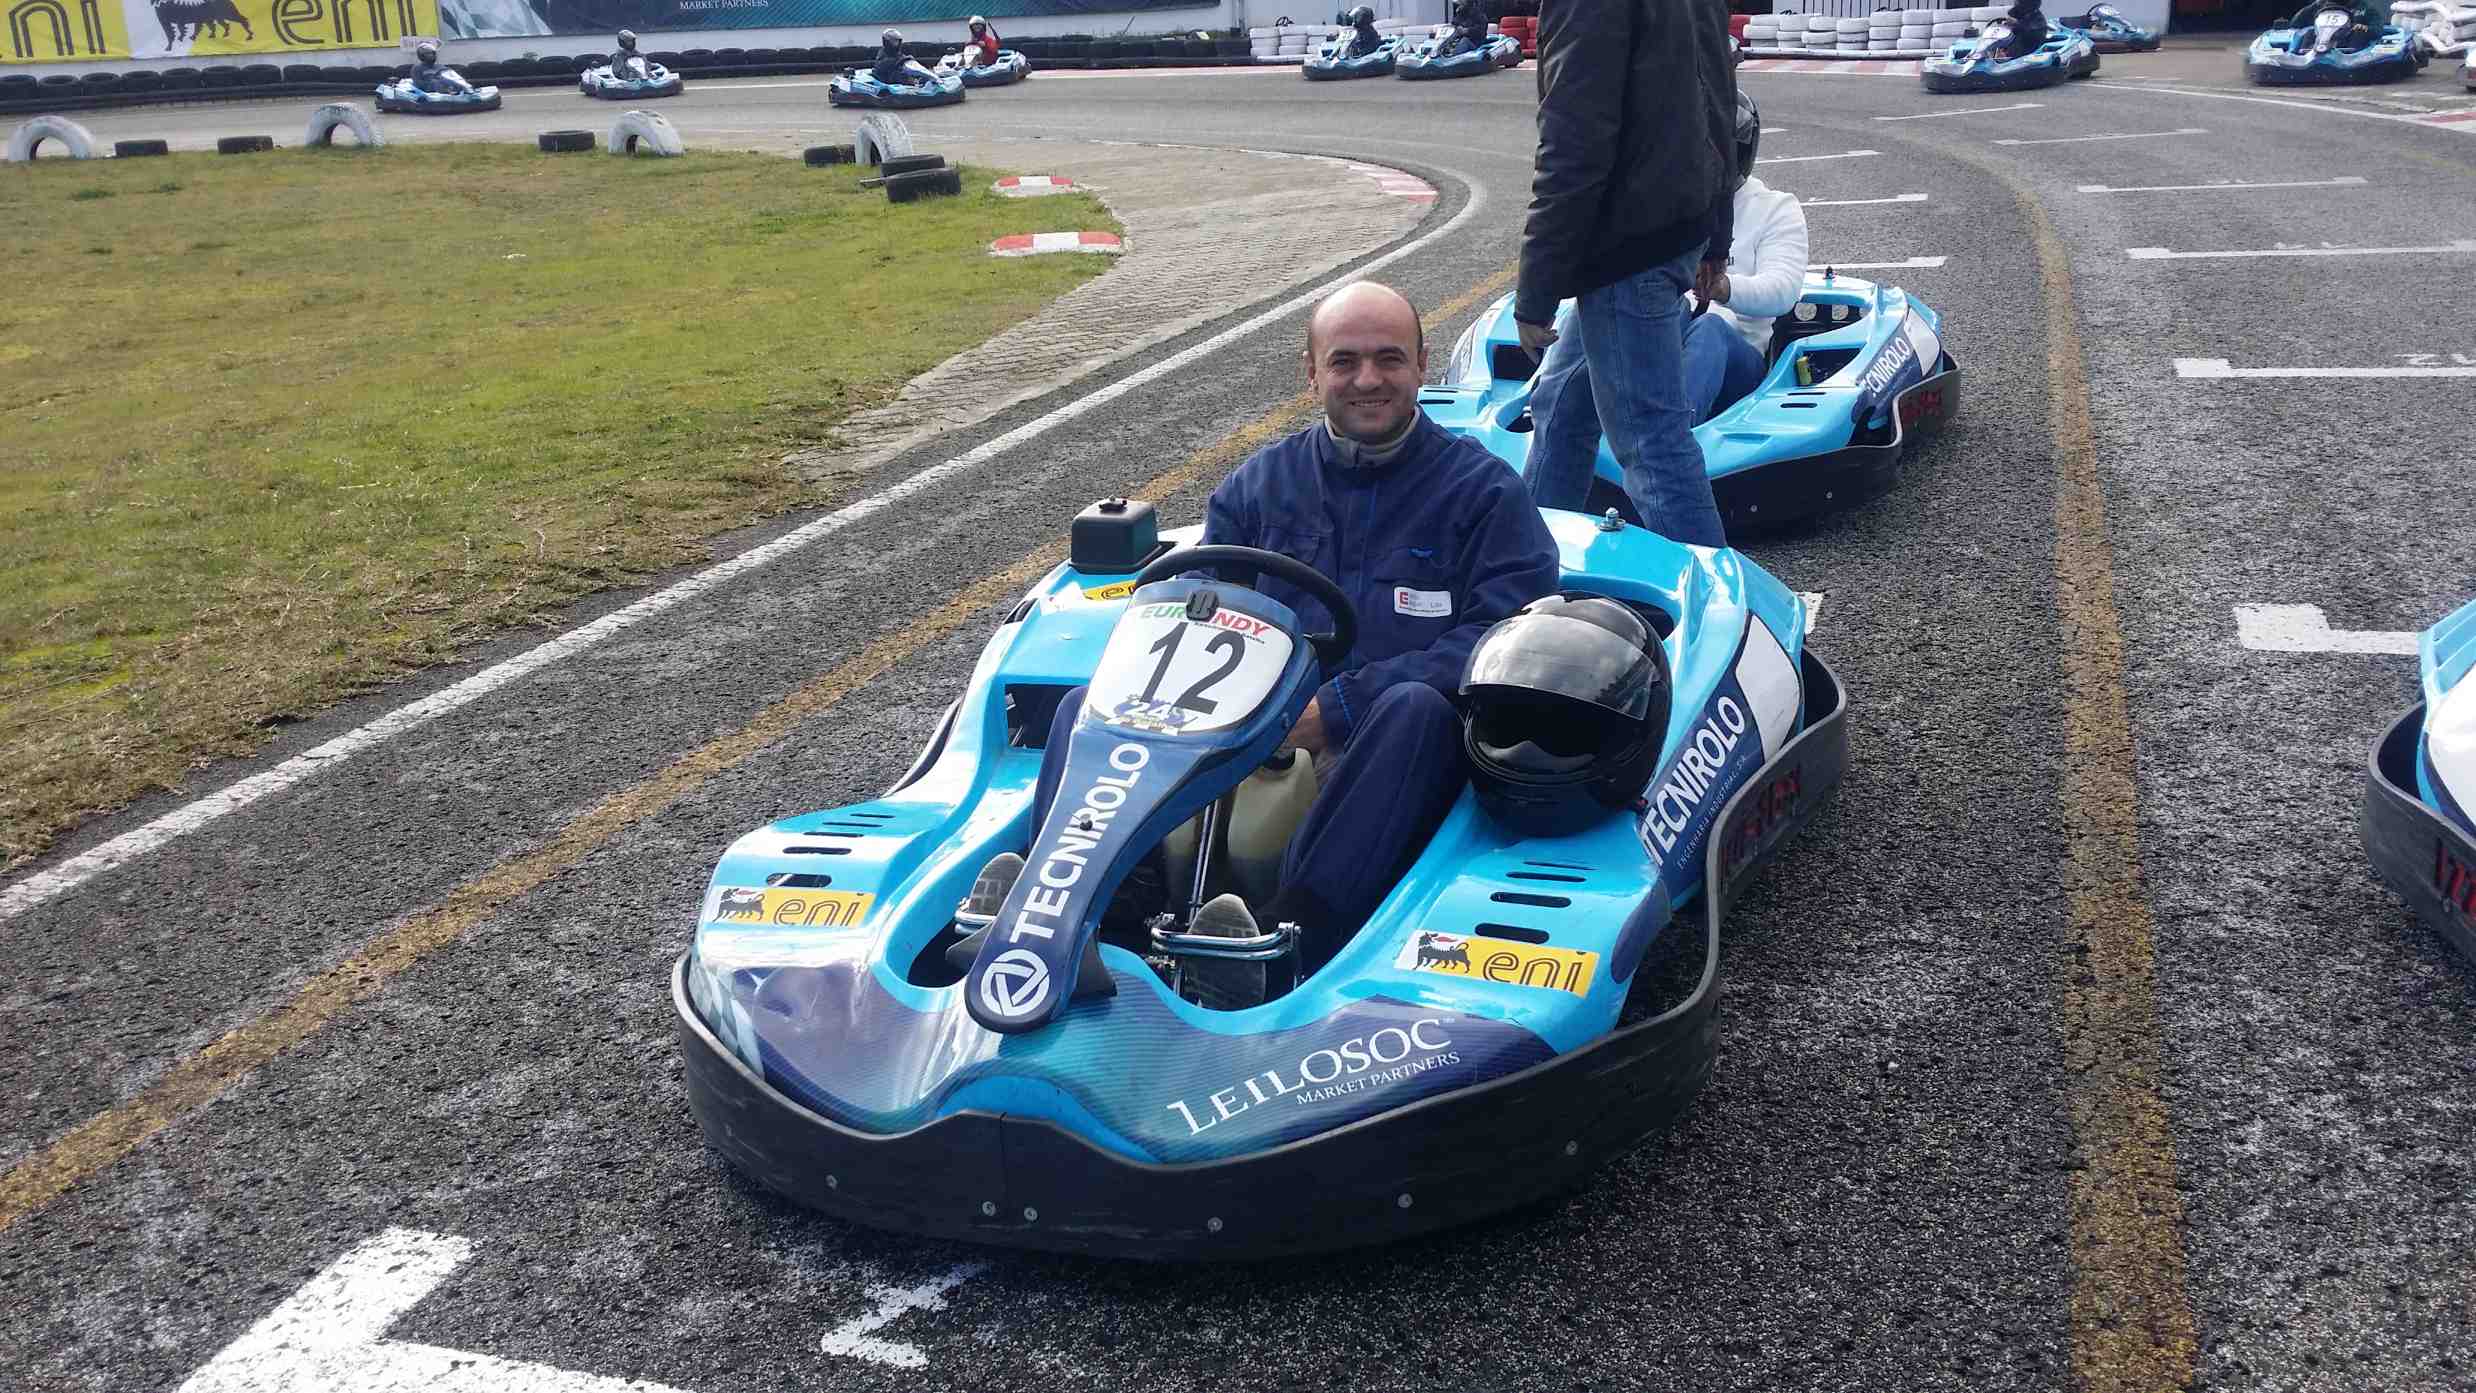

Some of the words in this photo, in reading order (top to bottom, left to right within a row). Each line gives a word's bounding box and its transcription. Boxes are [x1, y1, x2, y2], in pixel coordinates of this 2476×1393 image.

[1140, 622, 1245, 715] 12
[1639, 696, 1745, 867] TECNIROLO
[1009, 743, 1150, 943] TECNIROLO
[773, 892, 864, 926] eni
[1482, 950, 1587, 993] eni
[1167, 1018, 1452, 1136] LEILOSOC
[1296, 1077, 1366, 1105] MARKET
[1371, 1051, 1461, 1086] PARTNERS
